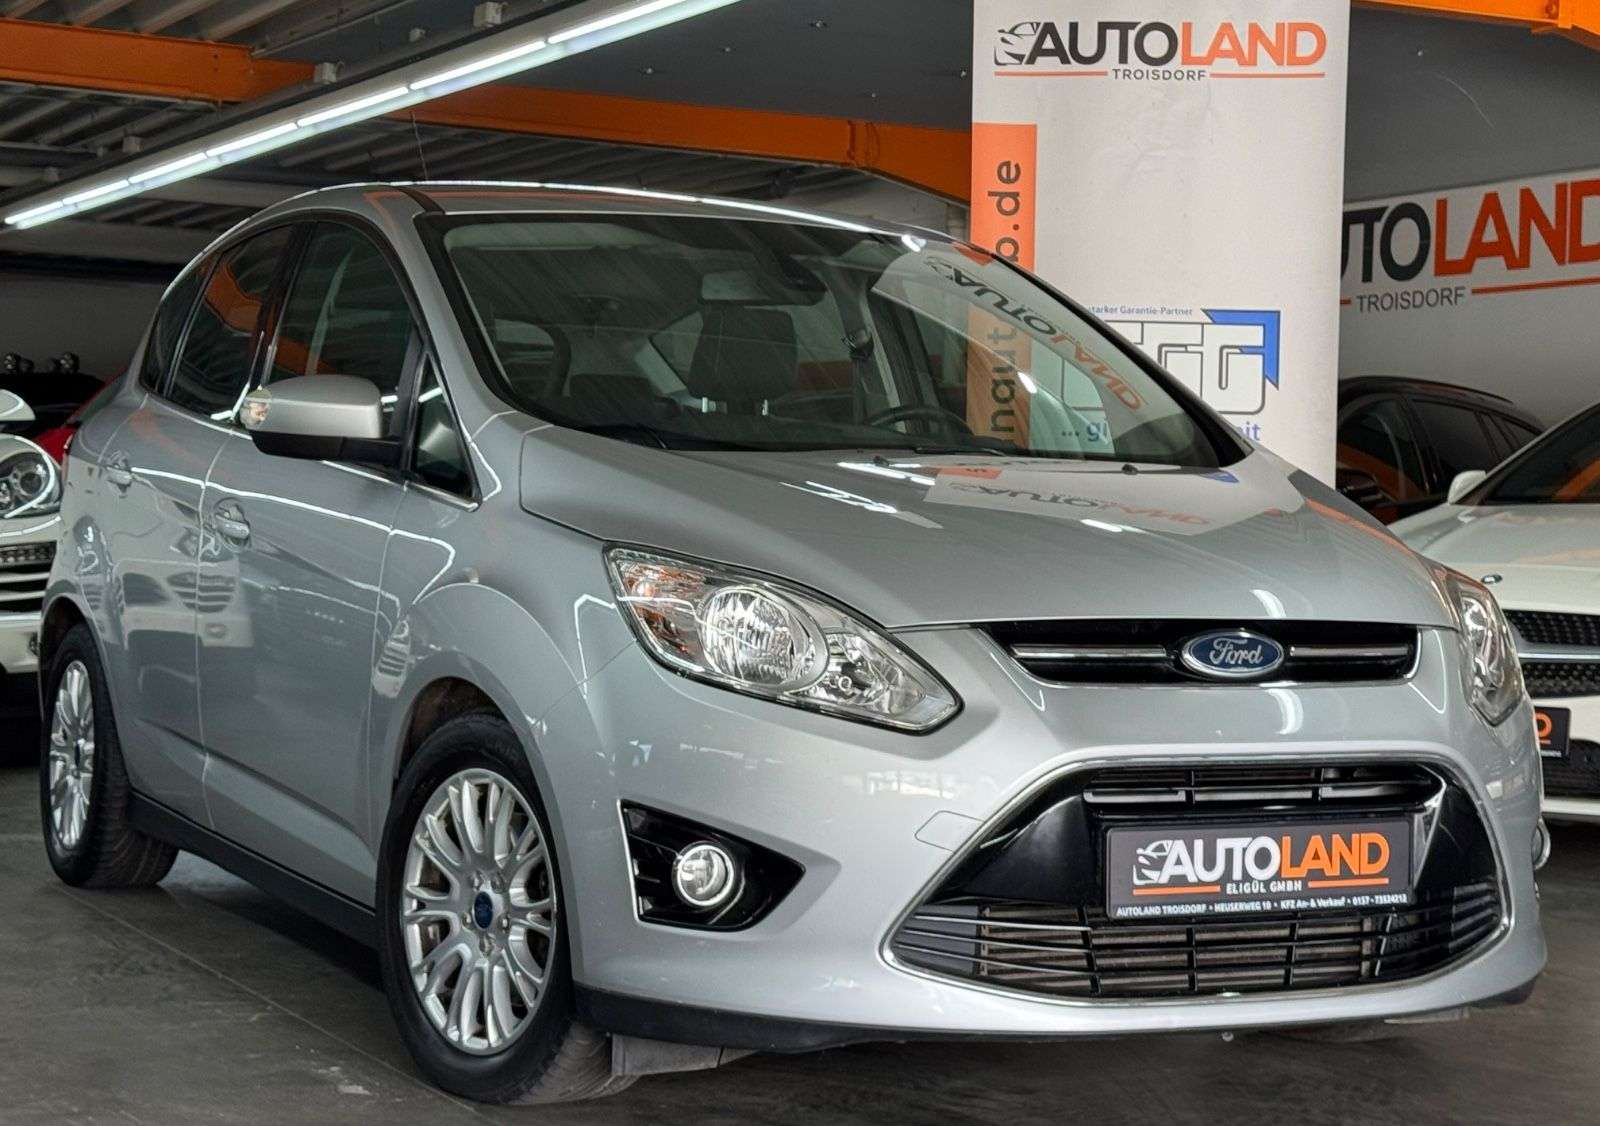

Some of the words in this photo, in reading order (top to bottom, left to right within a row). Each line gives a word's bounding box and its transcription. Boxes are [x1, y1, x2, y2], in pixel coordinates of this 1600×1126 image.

[1024, 21, 1327, 66] AUTOLAND
[1112, 68, 1208, 81] TROISDORF
[1341, 178, 1600, 284] TOLAND
[1089, 305, 1118, 314] tarker
[1356, 286, 1466, 313] TROISDORF
[1209, 637, 1264, 665] Ford
[1156, 831, 1391, 884] AUTOLAND
[1116, 905, 1161, 917] AUTOLAND
[1162, 903, 1207, 915] TROISDORF
